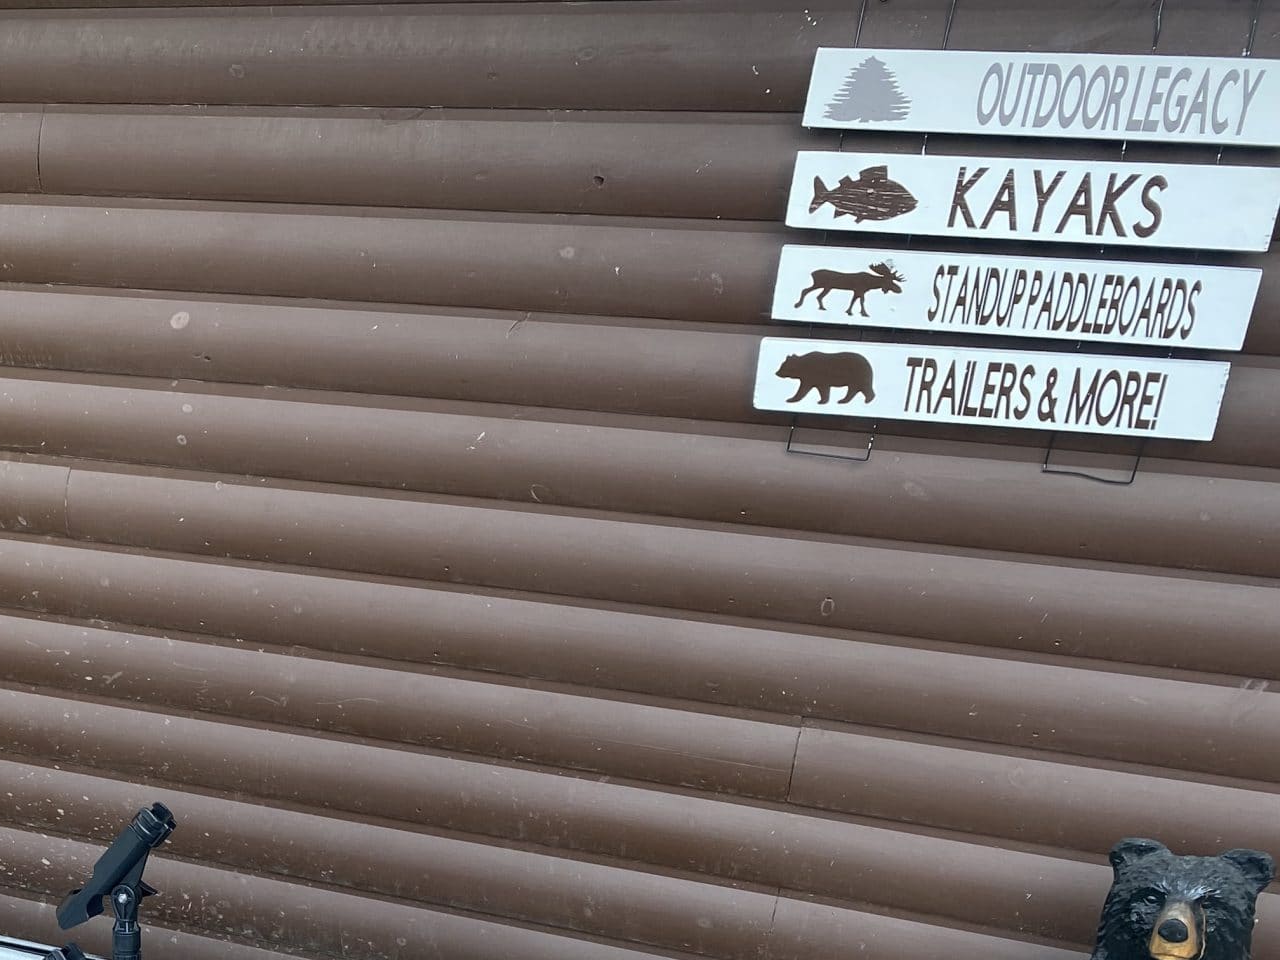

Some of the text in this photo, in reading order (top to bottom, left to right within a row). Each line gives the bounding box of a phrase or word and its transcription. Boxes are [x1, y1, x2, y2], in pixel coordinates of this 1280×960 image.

[946, 166, 1168, 239] KAYAKS
[903, 357, 1169, 431] TRAILERS & MORE!
